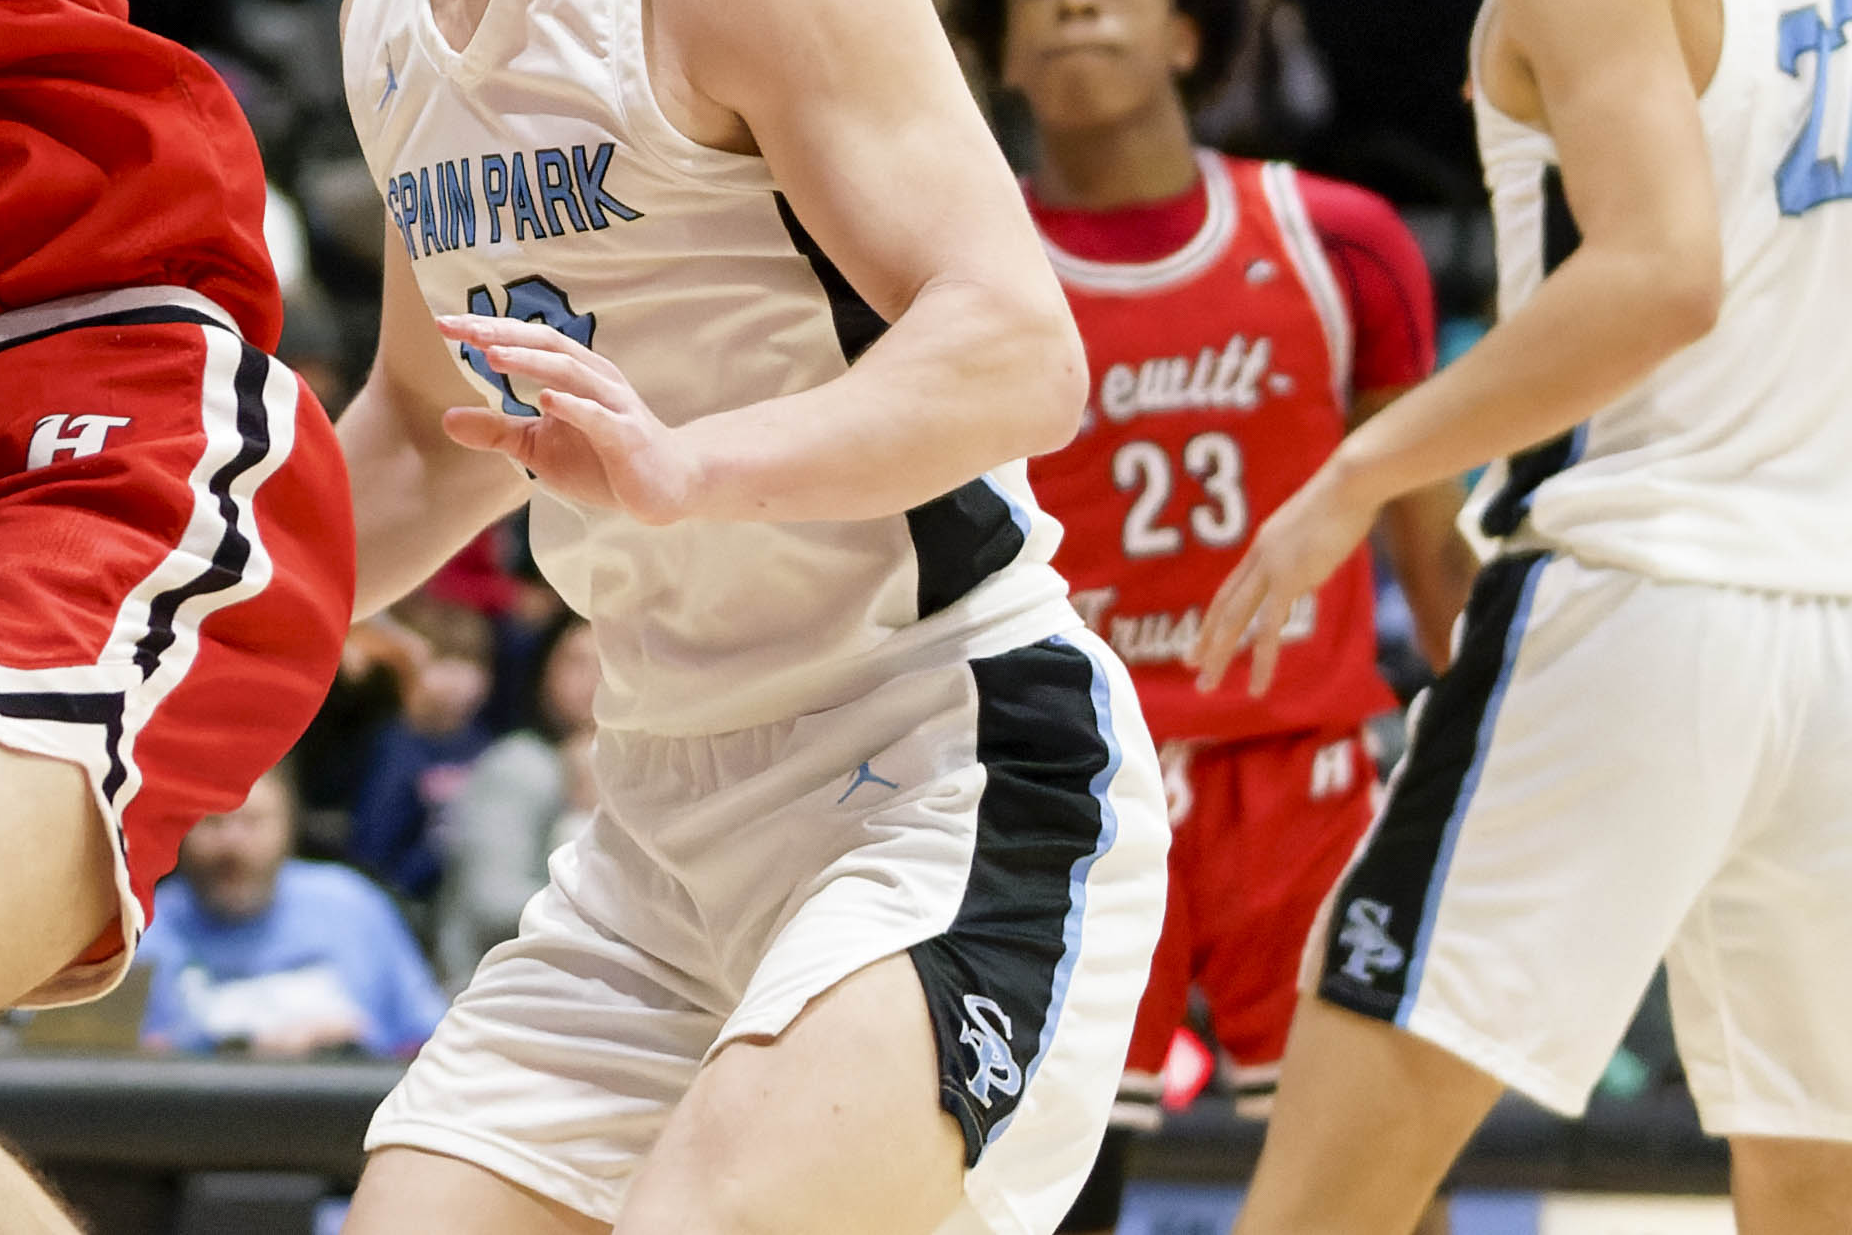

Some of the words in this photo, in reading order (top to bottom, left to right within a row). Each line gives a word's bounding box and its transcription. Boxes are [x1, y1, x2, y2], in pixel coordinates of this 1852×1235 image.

[481, 142, 645, 244] PARK
[1100, 333, 1294, 425] ewitt-
[1111, 430, 1248, 559] 23
